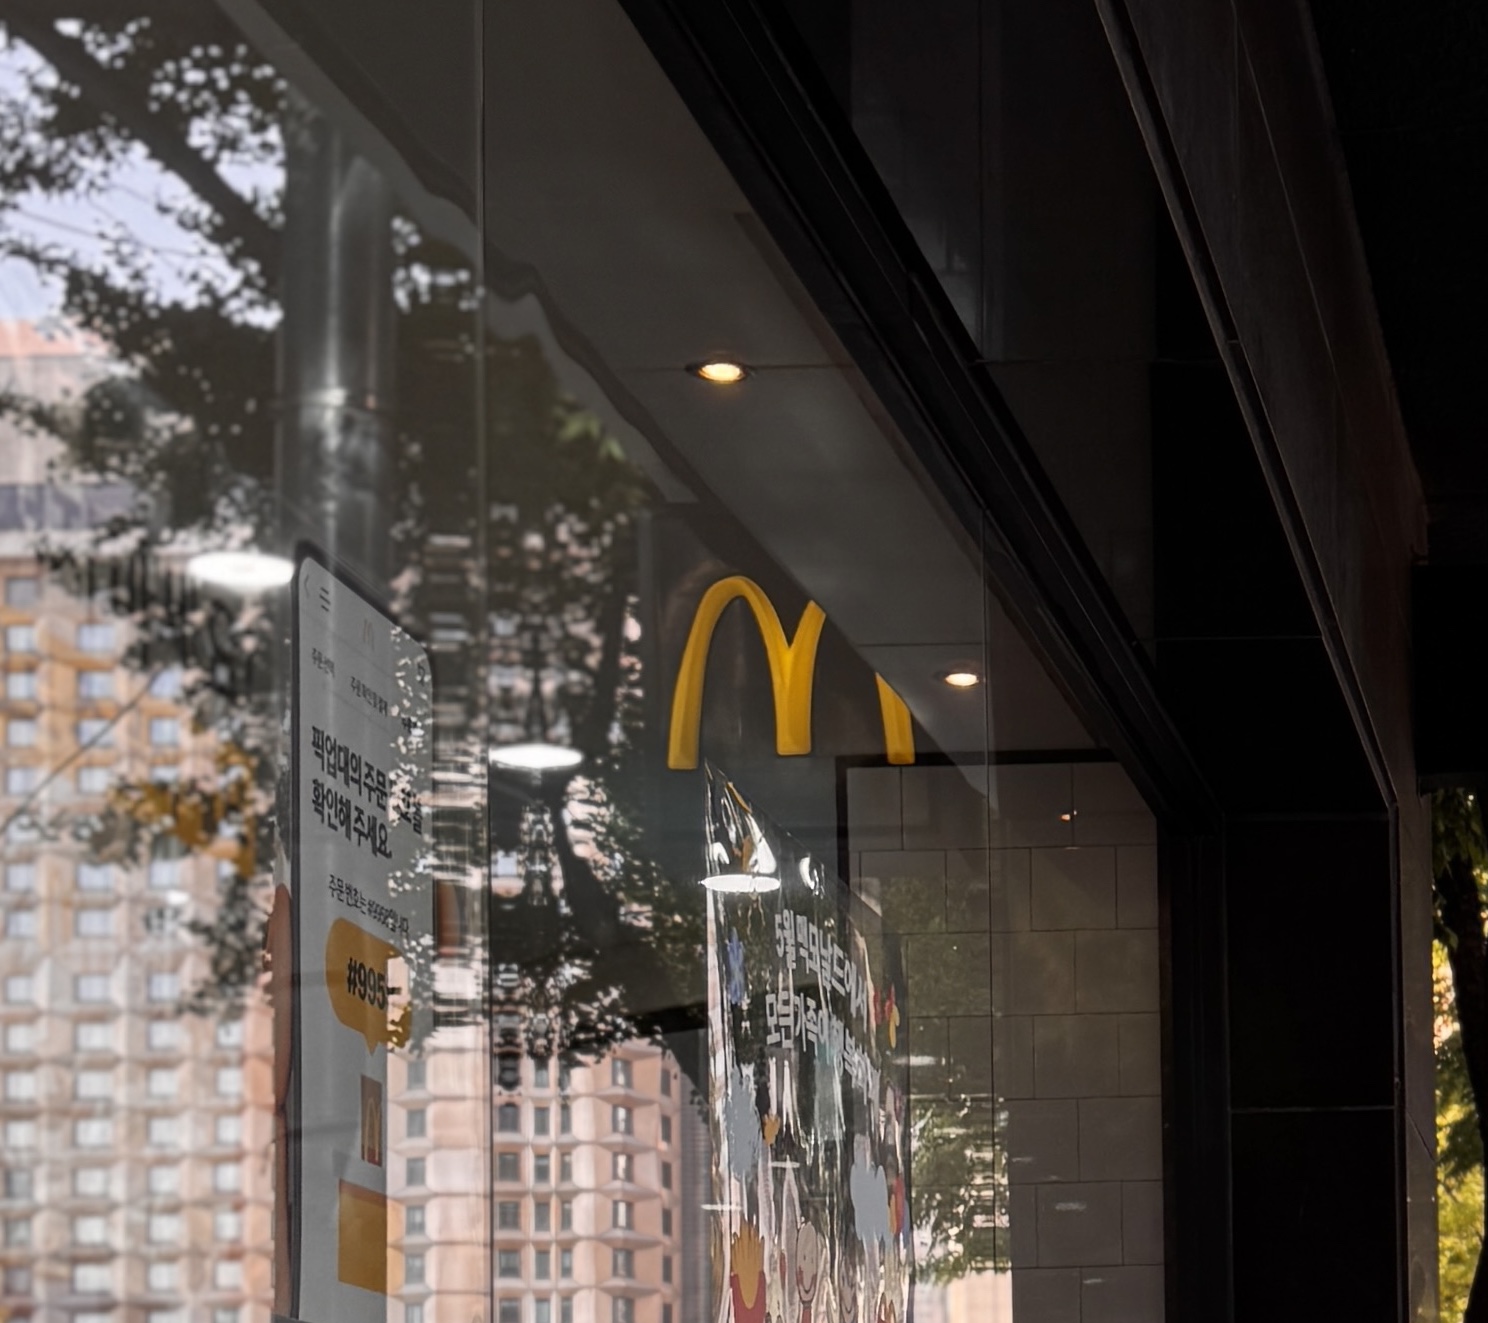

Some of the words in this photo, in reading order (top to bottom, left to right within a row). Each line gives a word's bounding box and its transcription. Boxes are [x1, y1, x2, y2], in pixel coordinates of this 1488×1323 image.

[312, 726, 362, 797] 픽업대의
[363, 761, 388, 812] 주문
[312, 778, 351, 842] 확인해
[774, 908, 796, 970] 5월
[765, 990, 794, 1049] 모든
